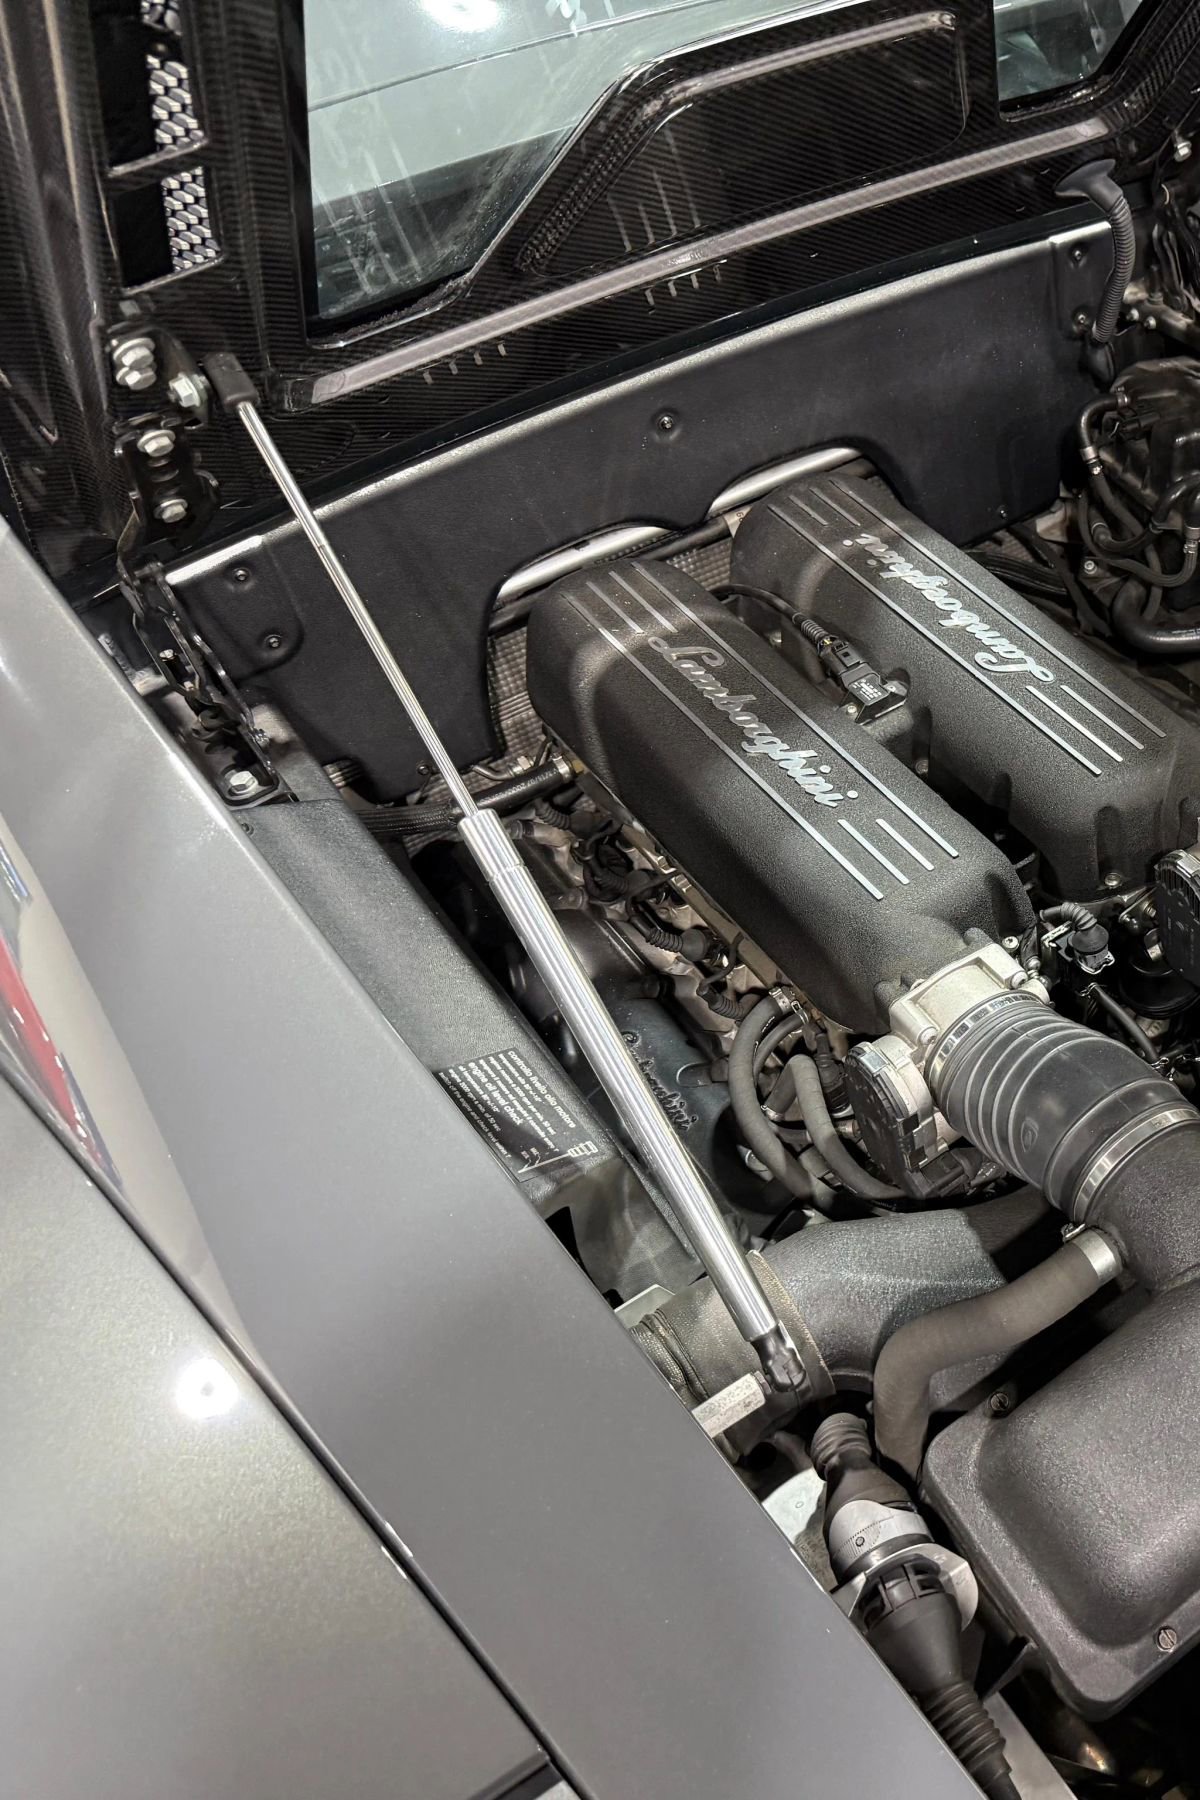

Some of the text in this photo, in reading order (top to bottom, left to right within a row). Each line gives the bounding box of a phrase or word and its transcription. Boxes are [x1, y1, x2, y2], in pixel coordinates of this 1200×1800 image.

[842, 533, 1054, 682] Lamborghini
[648, 637, 858, 808] Lamborghini
[468, 1062, 523, 1124] engine oil level check
[508, 1051, 575, 1127] controllo livello olio motore
